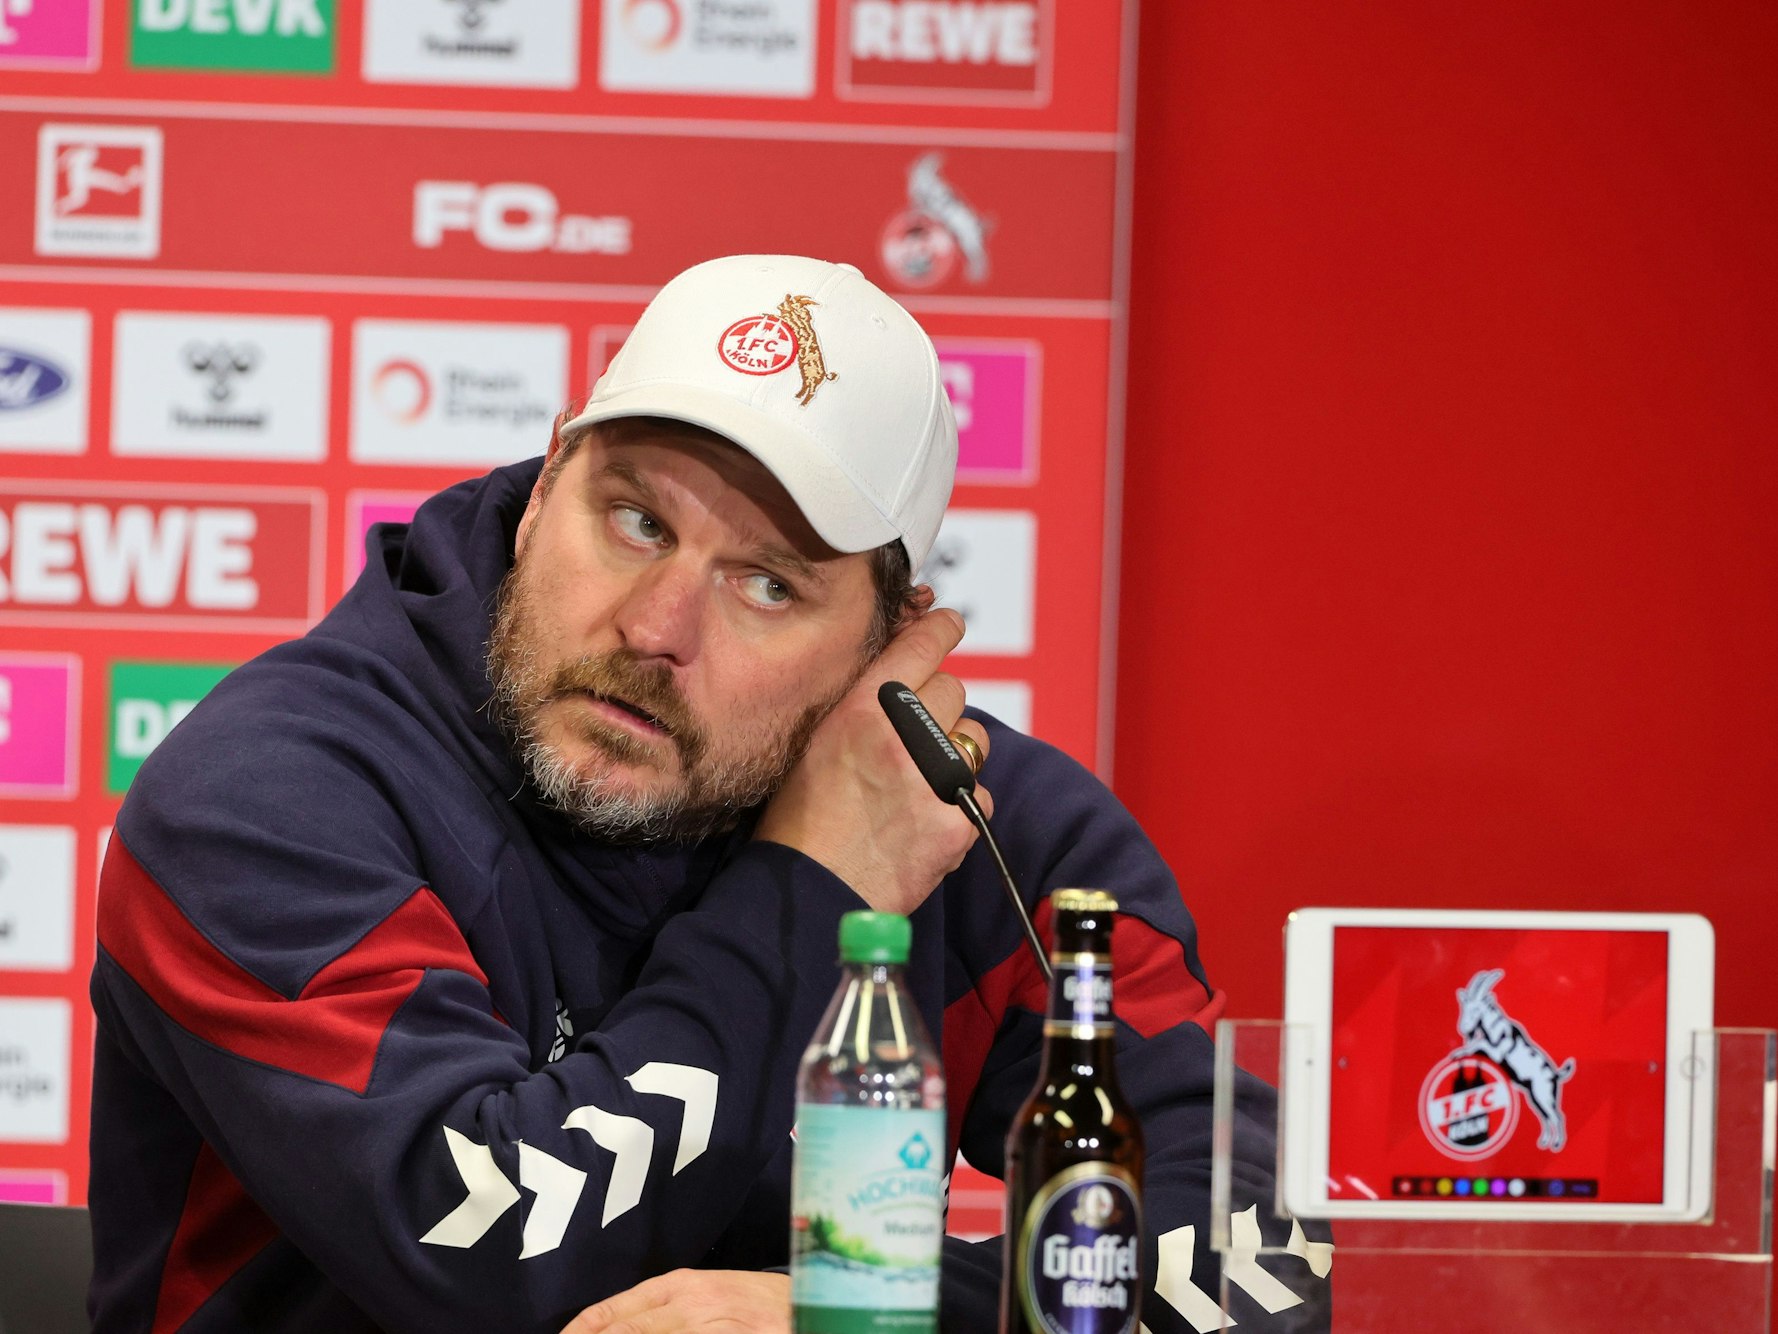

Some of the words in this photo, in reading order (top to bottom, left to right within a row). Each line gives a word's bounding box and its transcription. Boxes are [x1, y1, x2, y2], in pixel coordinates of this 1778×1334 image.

[854, 2, 1035, 65] REWE
[728, 350, 769, 368] KÖLN
[0, 501, 259, 609] EWE
[910, 703, 960, 761] SENNHEISER
